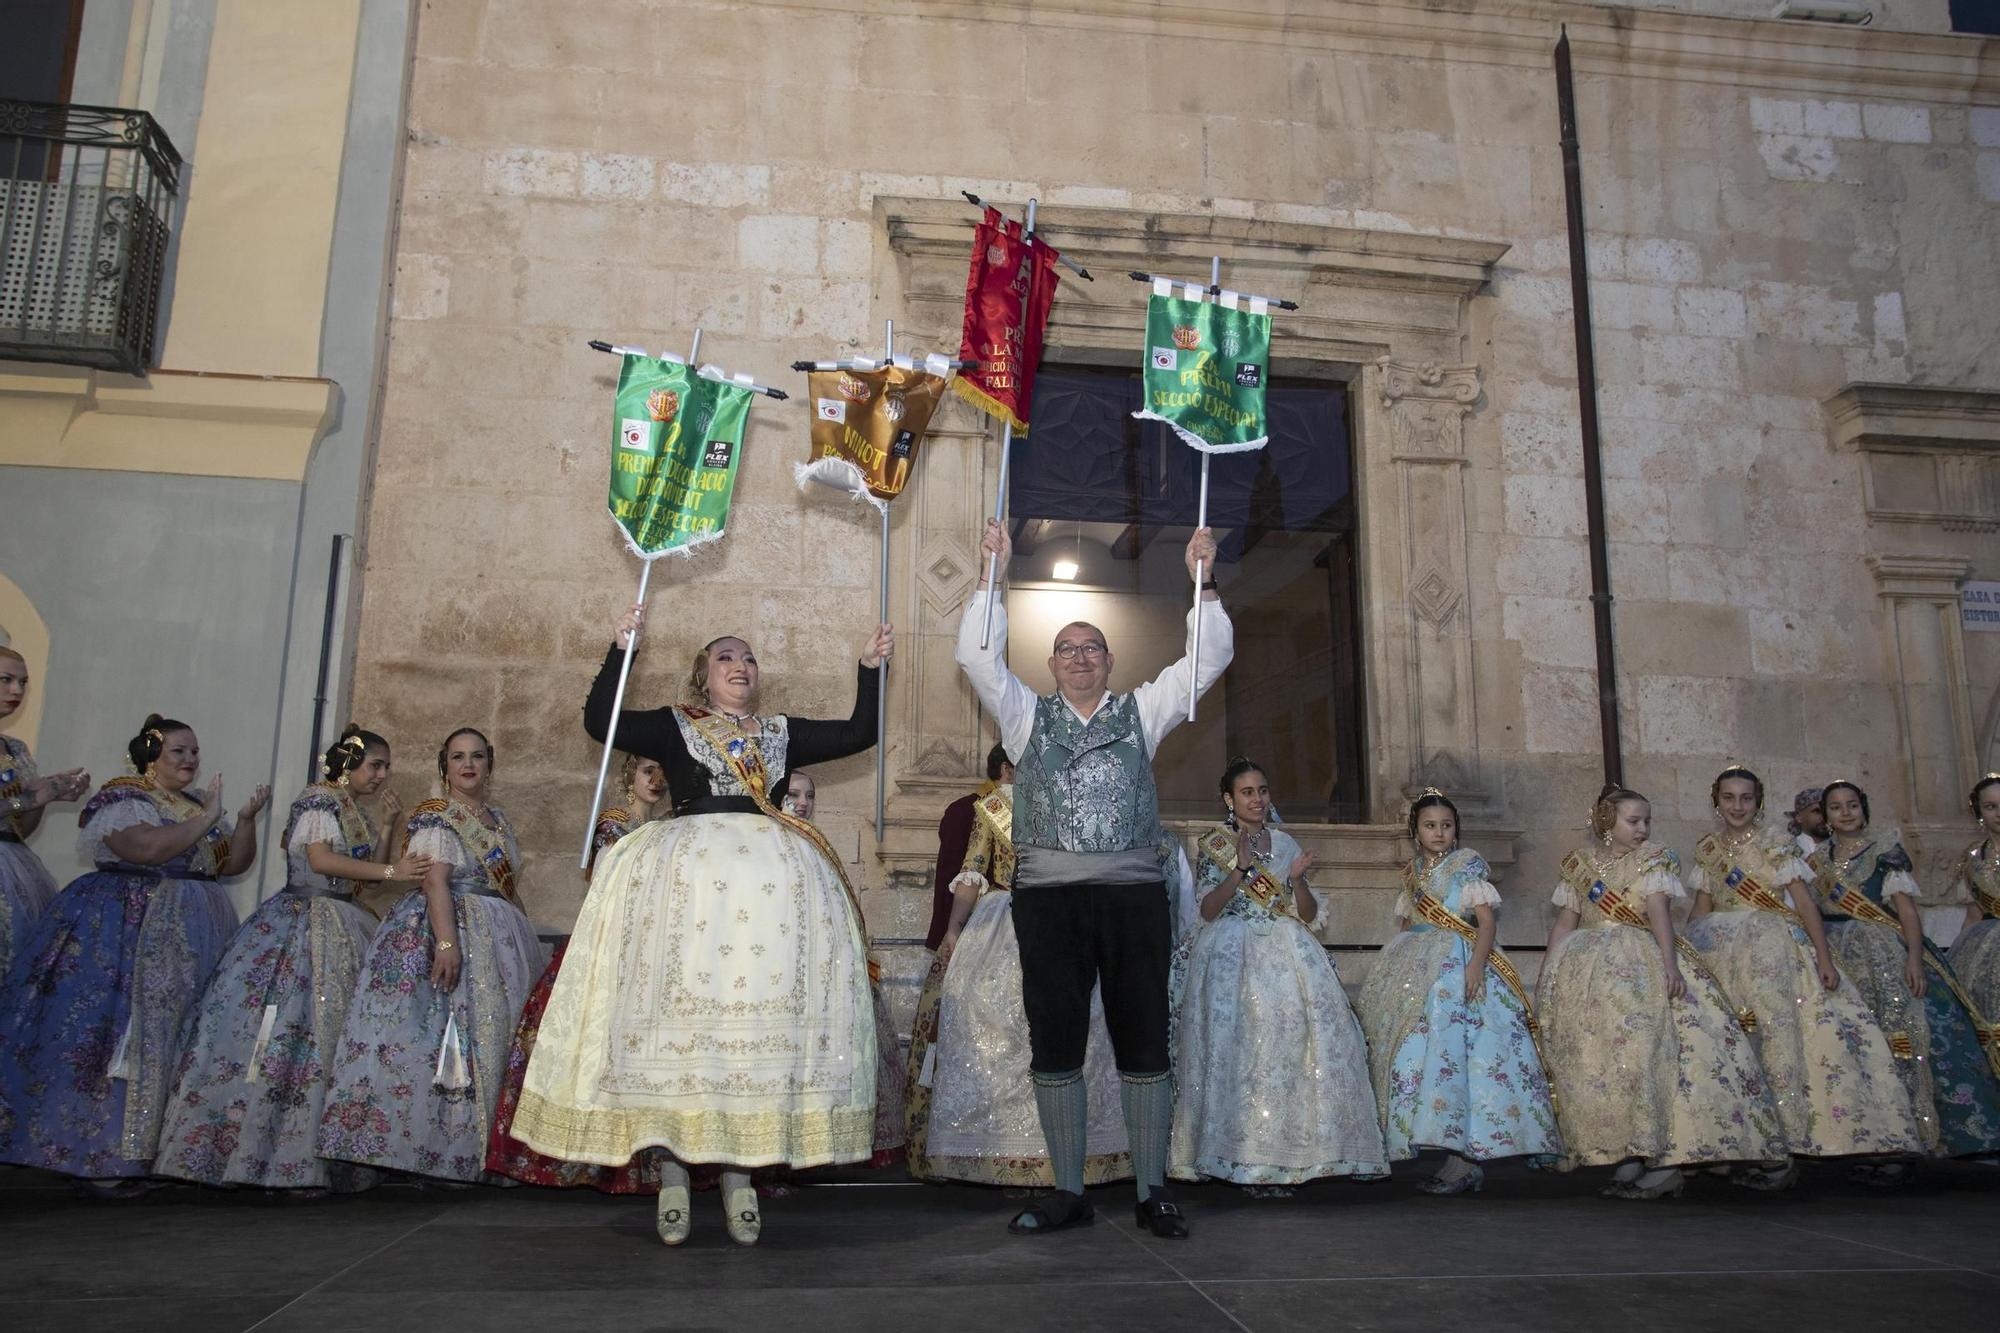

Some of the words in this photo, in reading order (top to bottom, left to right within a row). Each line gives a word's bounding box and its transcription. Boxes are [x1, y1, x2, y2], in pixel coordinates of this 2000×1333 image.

[993, 344, 1011, 356] LA
[986, 376, 1020, 391] FALL
[1181, 370, 1231, 398] PREMI
[1237, 374, 1259, 382] FLEX
[1154, 390, 1202, 408] SECCIÓ
[1204, 395, 1258, 429] ESPECIAL
[706, 453, 729, 462] FLEX
[844, 426, 888, 471] NINOT
[618, 452, 654, 475] PREMI
[652, 504, 715, 533] ESPECIAL
[1963, 610, 2000, 622] SISTOR
